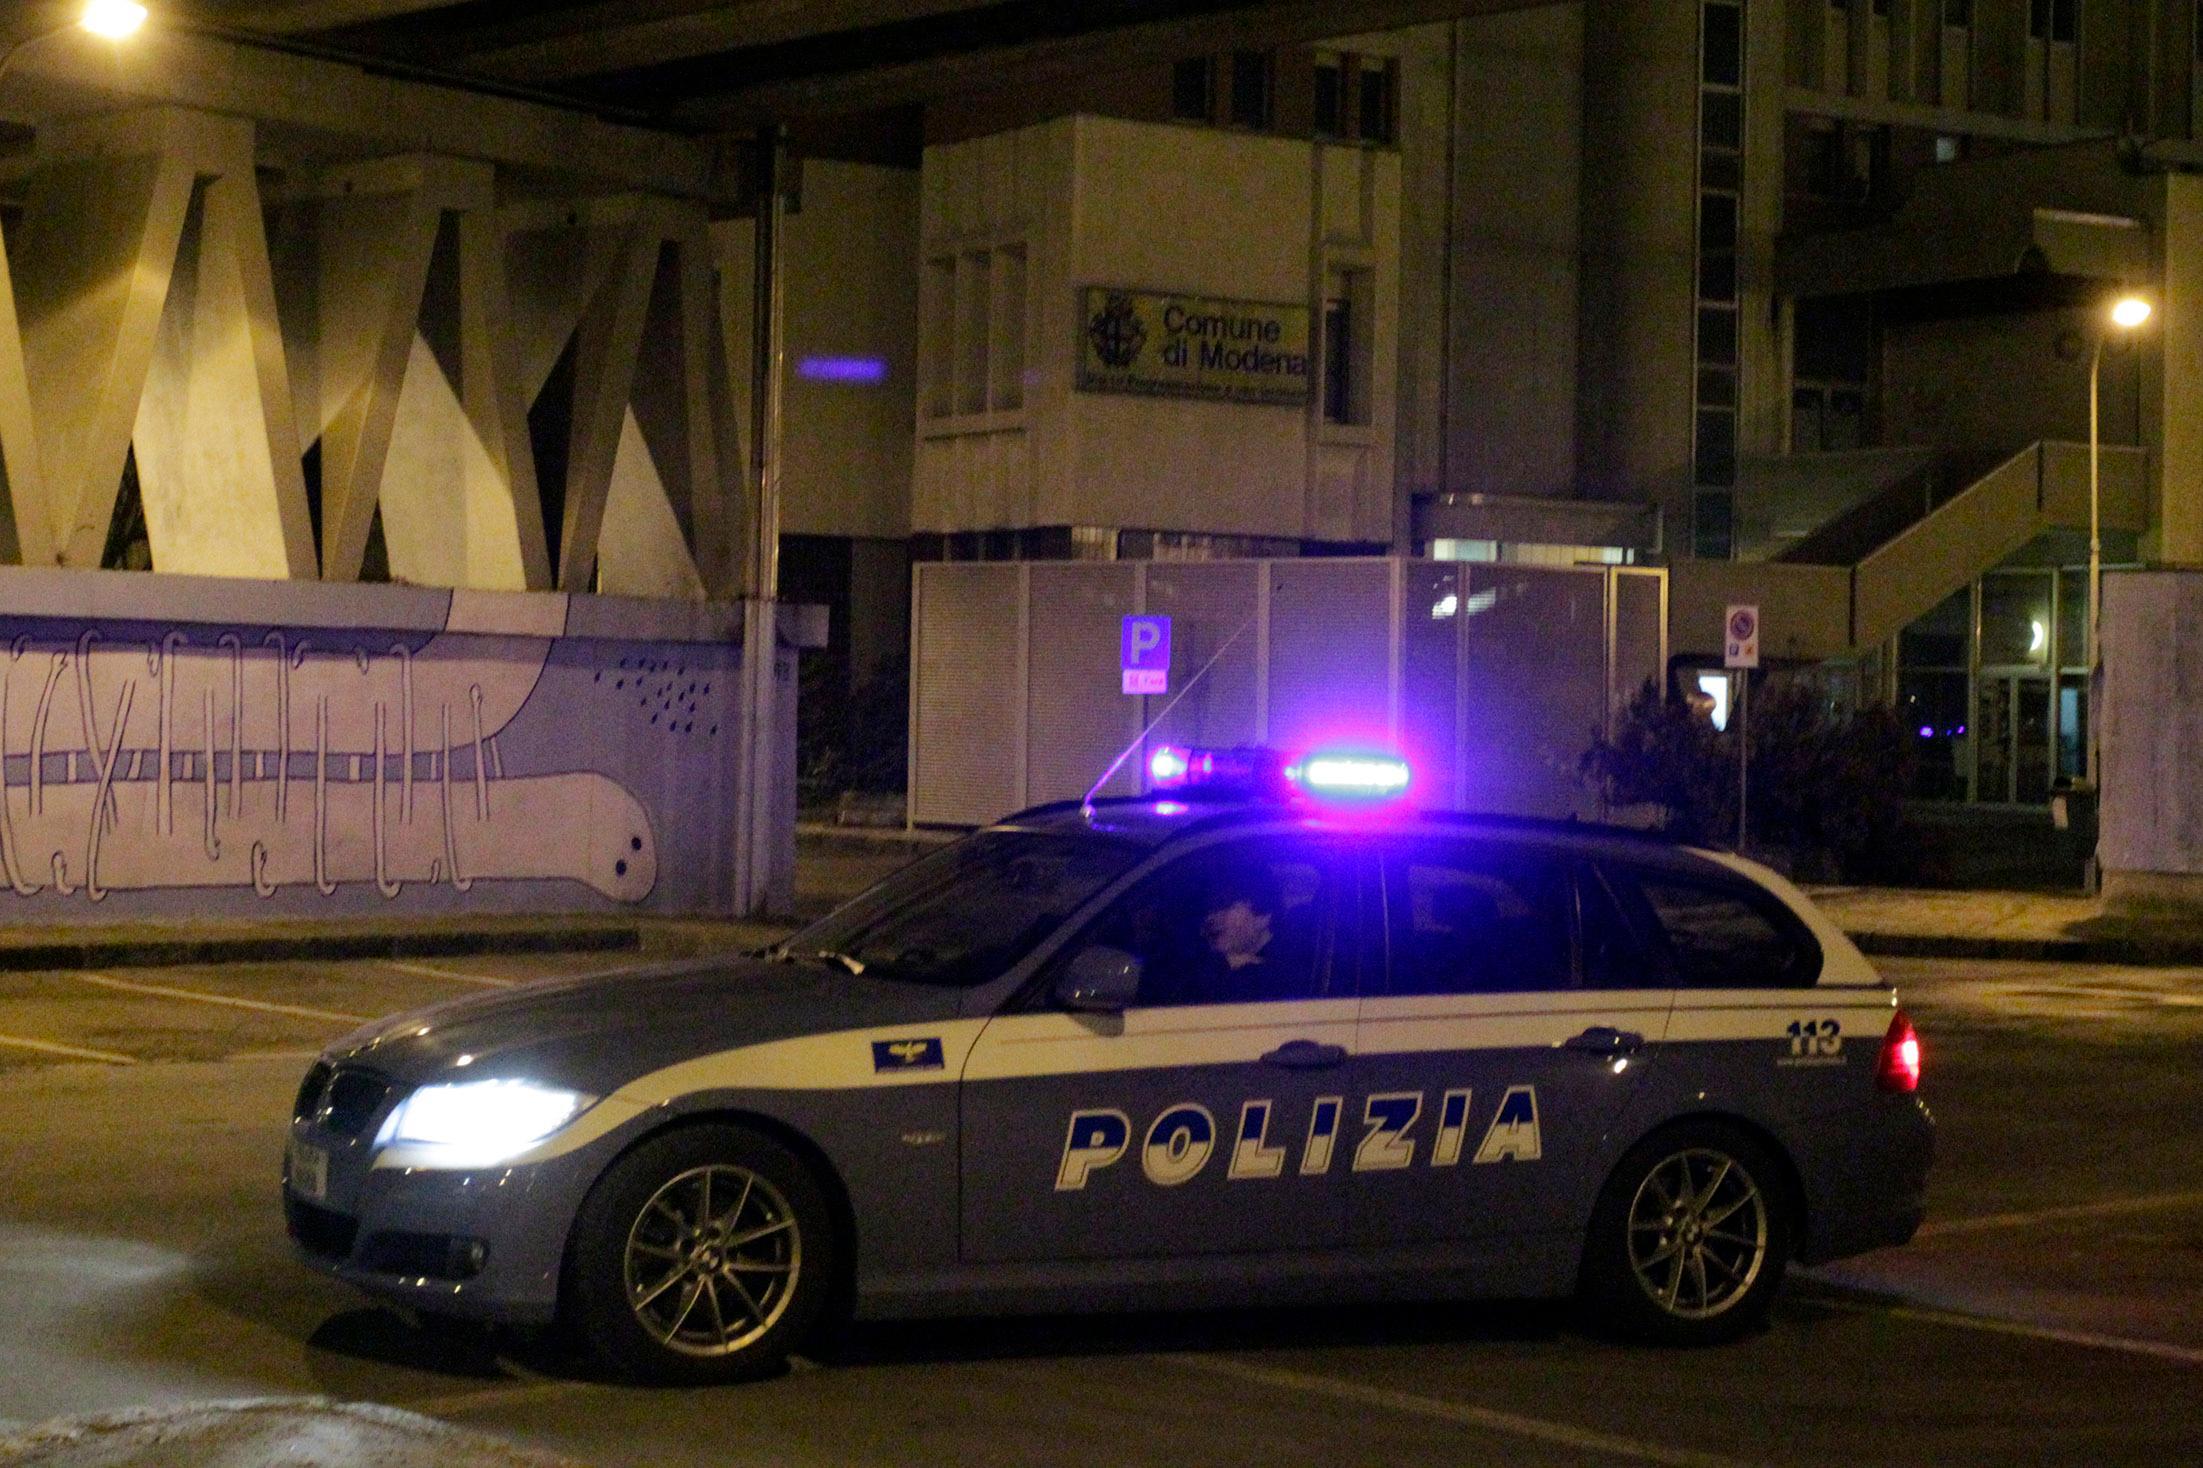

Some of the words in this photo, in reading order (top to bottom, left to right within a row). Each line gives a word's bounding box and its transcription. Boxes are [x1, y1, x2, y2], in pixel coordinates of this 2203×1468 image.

[1164, 304, 1281, 342] Comune
[1163, 340, 1187, 367] di
[1201, 341, 1307, 376] Modena
[1130, 621, 1160, 665] P
[1787, 1019, 1842, 1056] 113
[1054, 1083, 1543, 1192] POLIZIA
